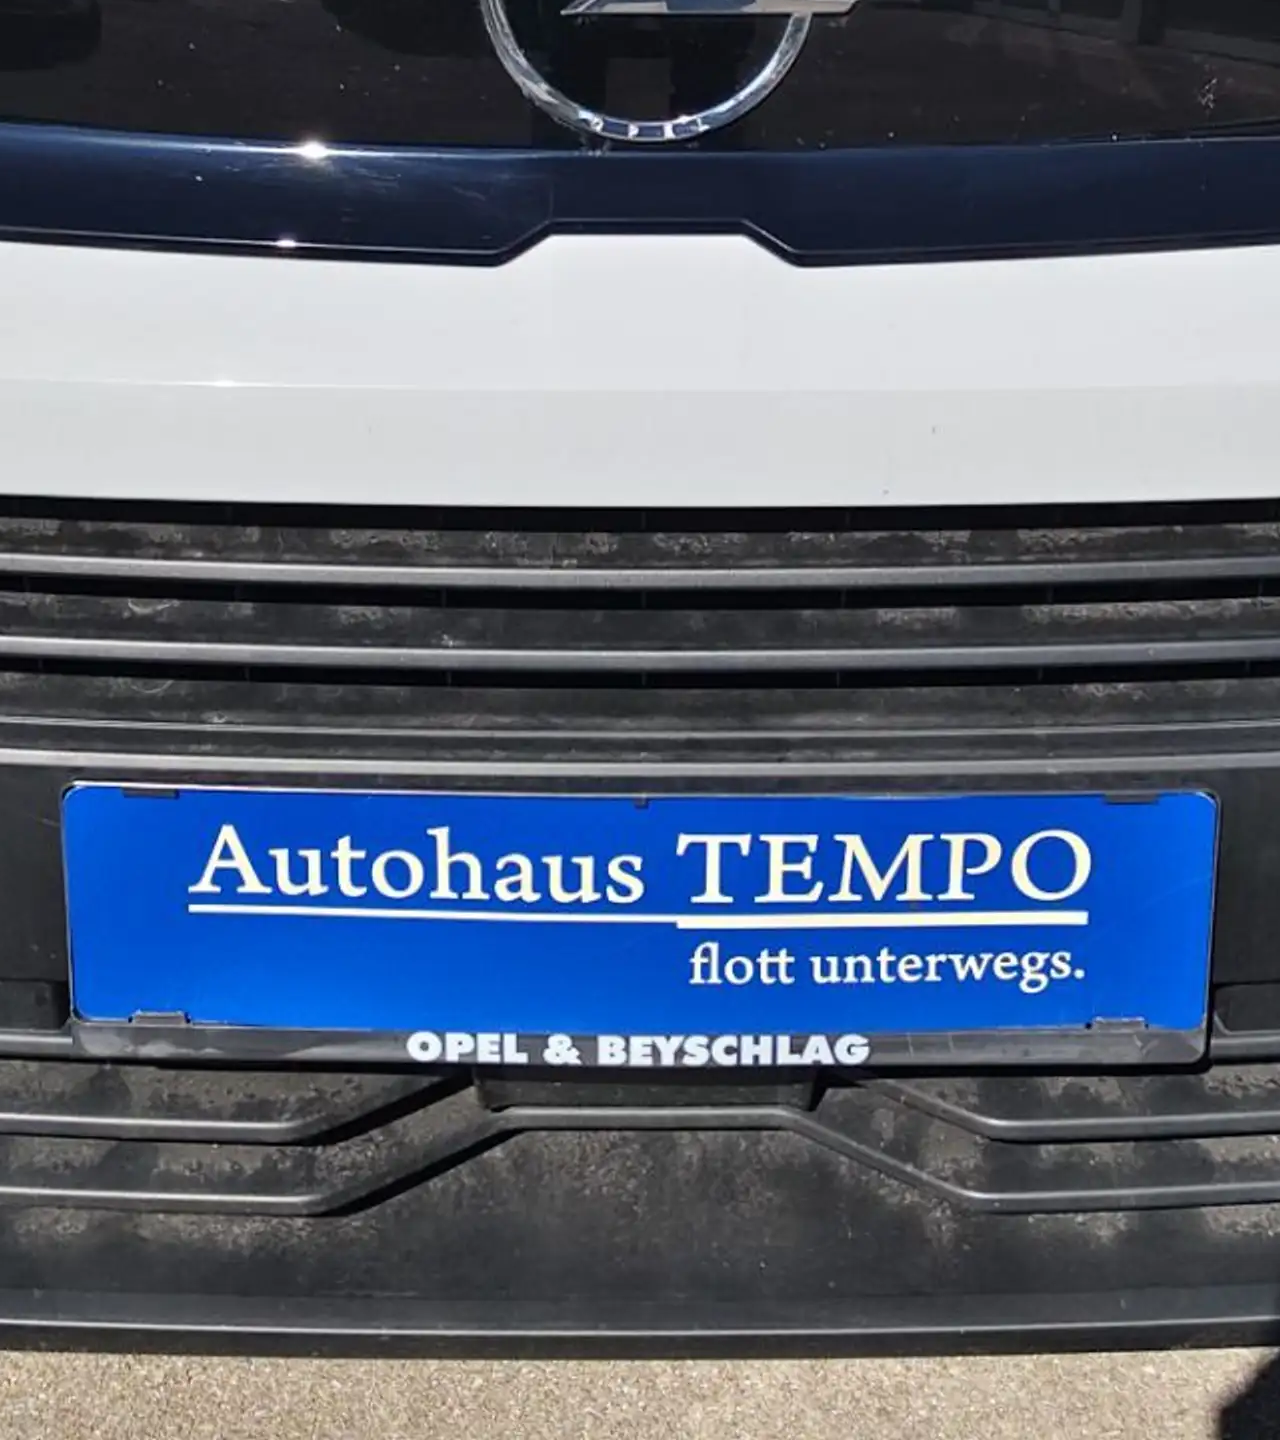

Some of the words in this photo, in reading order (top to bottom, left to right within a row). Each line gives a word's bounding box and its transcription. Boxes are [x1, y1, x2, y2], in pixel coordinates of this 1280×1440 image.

[188, 824, 644, 904] Autohaus
[676, 829, 1091, 903] TEMPO
[690, 942, 795, 985] flott
[810, 948, 1084, 993] unterwegs.
[406, 1031, 529, 1064] OPEL
[542, 1034, 582, 1065] &
[597, 1034, 871, 1067] BEYSCHLAG
